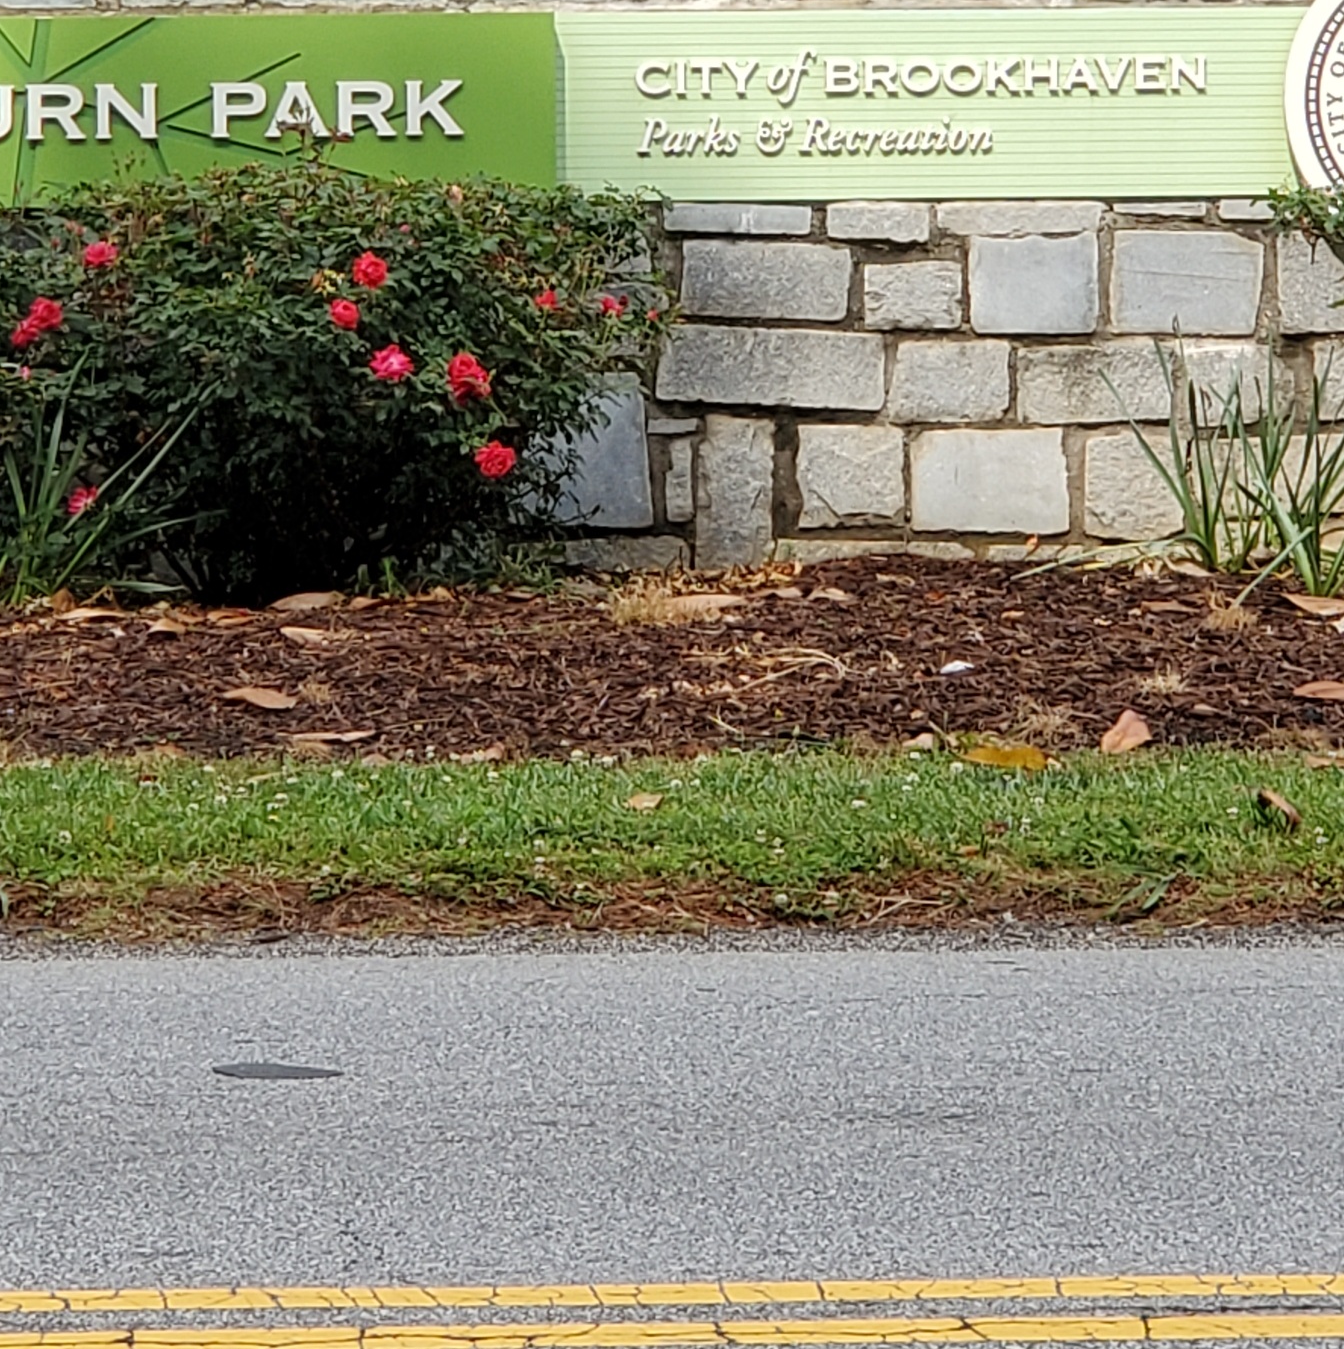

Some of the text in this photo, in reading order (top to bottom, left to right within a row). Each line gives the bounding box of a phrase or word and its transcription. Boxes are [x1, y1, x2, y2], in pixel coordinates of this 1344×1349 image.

[635, 48, 1208, 109] CITY of BROOKHAVEN
[210, 79, 465, 142] PARK
[637, 115, 994, 157] Parks & Recreation
